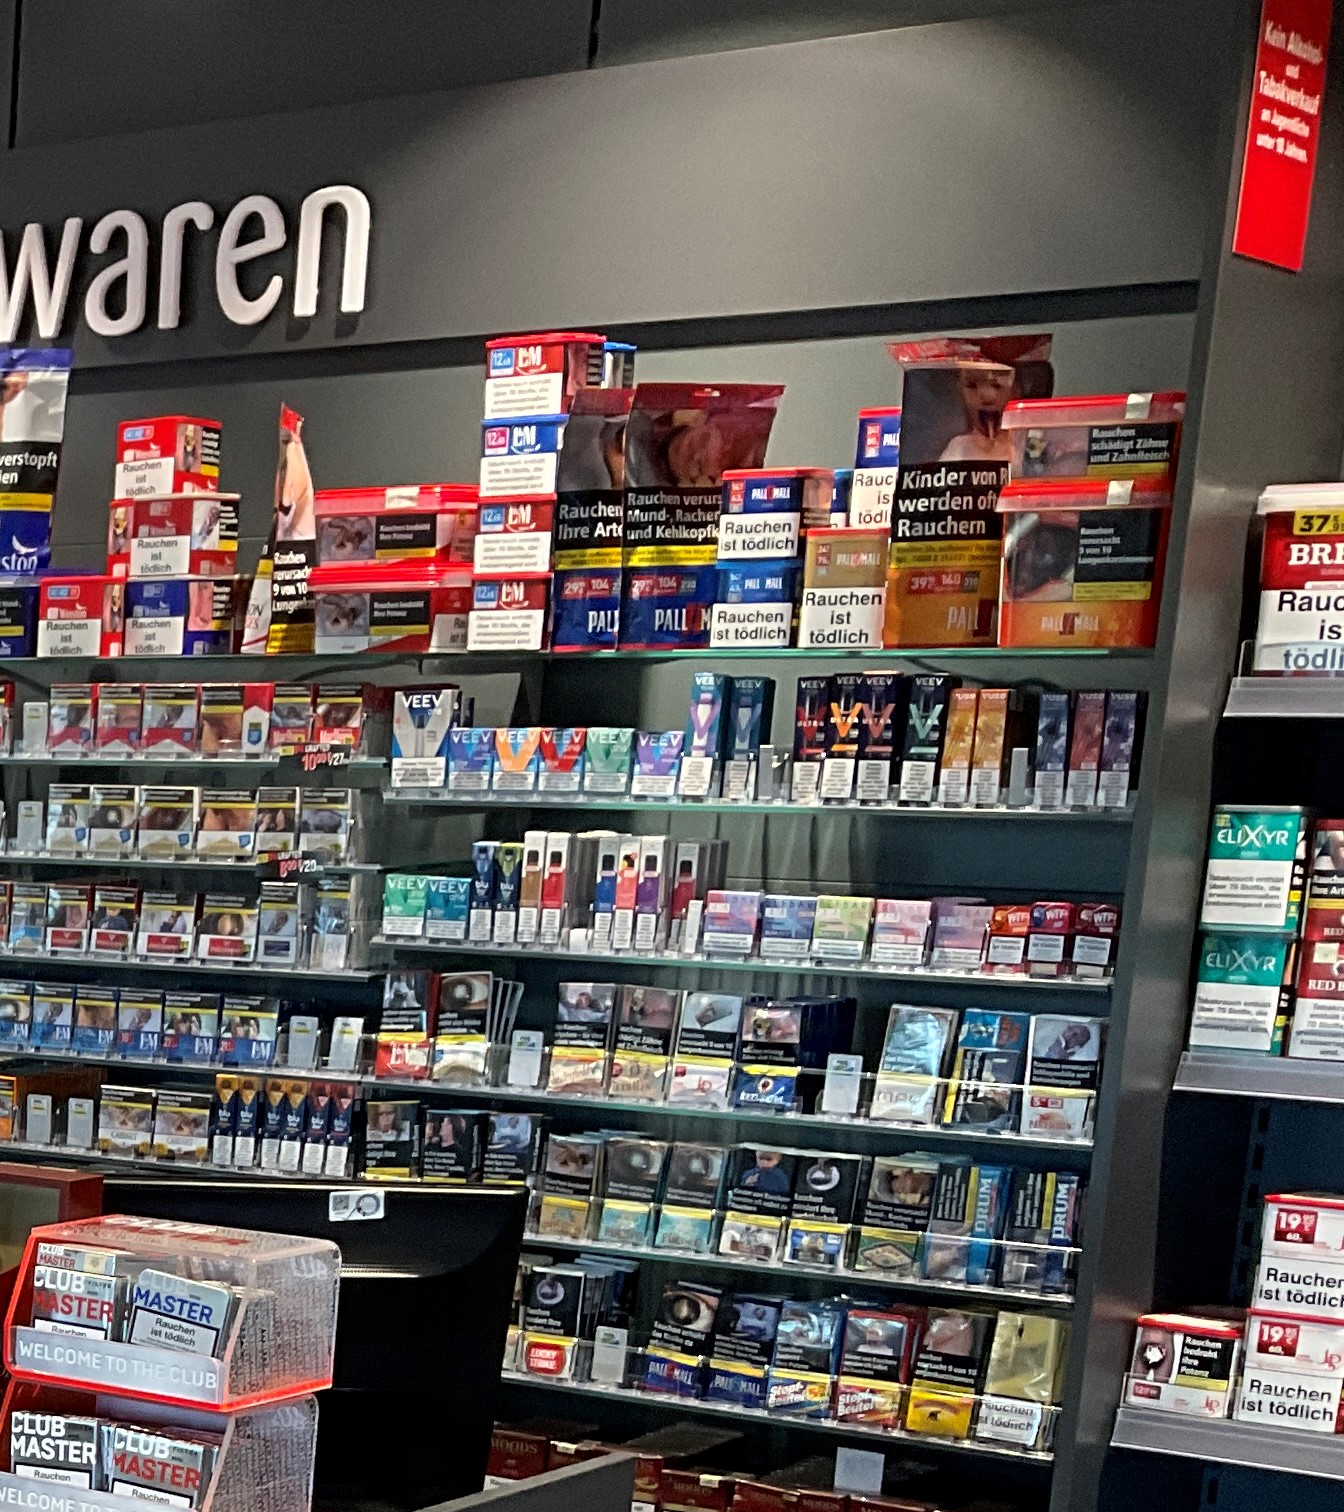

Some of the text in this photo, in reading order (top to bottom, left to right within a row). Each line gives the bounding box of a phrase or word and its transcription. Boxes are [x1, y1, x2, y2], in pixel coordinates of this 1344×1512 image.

[1090, 451, 1109, 462] und
[122, 461, 161, 473] Rauchen
[901, 469, 997, 490] Kinder von
[125, 485, 156, 497] tödlich
[751, 487, 791, 500] PALL MALL
[627, 493, 681, 506] Rauchen
[898, 493, 973, 512] werden
[724, 522, 792, 535] Rauchen
[897, 518, 987, 537] Rauchern
[1300, 514, 1330, 532] 37
[558, 524, 590, 539] Ihre
[627, 526, 653, 539] und
[137, 539, 178, 549] Rauchen
[720, 536, 794, 551] ist tödlich
[140, 563, 172, 573] tödlich
[744, 577, 783, 590] PALL MALL
[805, 592, 883, 607] Rauchen
[131, 620, 172, 629] Rauchen
[717, 611, 784, 624] Rauchen
[830, 611, 852, 625] ist
[46, 621, 88, 632] Rauchen
[713, 626, 787, 641] ist tödlich
[809, 629, 870, 645] tödlich
[49, 645, 83, 655] tödlich
[134, 643, 166, 654] tödlich
[915, 675, 944, 687] VEEV
[401, 693, 444, 708] VEEV
[450, 729, 492, 744] VEEV
[497, 728, 540, 744] VEEV
[1216, 825, 1289, 848] ELIXYR
[387, 877, 428, 891] VEEV
[429, 881, 469, 894] VEEV
[1206, 949, 1276, 972] ELIXYR
[975, 1177, 993, 1233] DRUM
[1051, 1181, 1077, 1242] DRUM
[37, 1254, 76, 1269] MASTER
[34, 1267, 86, 1293] CLUB
[1259, 1285, 1281, 1300] ist
[34, 1289, 114, 1320] MASTER
[133, 1286, 214, 1324] MASTER
[149, 1328, 165, 1340] ist
[155, 1317, 196, 1337] Rauchen
[530, 1348, 560, 1360] LUCKY
[19, 1339, 218, 1389] WELCOME TO THE CLUB
[529, 1359, 559, 1373] STRIKE
[770, 1382, 805, 1398] Stopf-
[1249, 1379, 1332, 1402] Rauchen
[839, 1392, 870, 1408] Stopf-
[1242, 1396, 1334, 1422] ist tödlich
[12, 1411, 66, 1437] CLUB
[11, 1435, 97, 1465] MASTER
[114, 1428, 171, 1460] CLUB
[112, 1452, 200, 1489] MASTER
